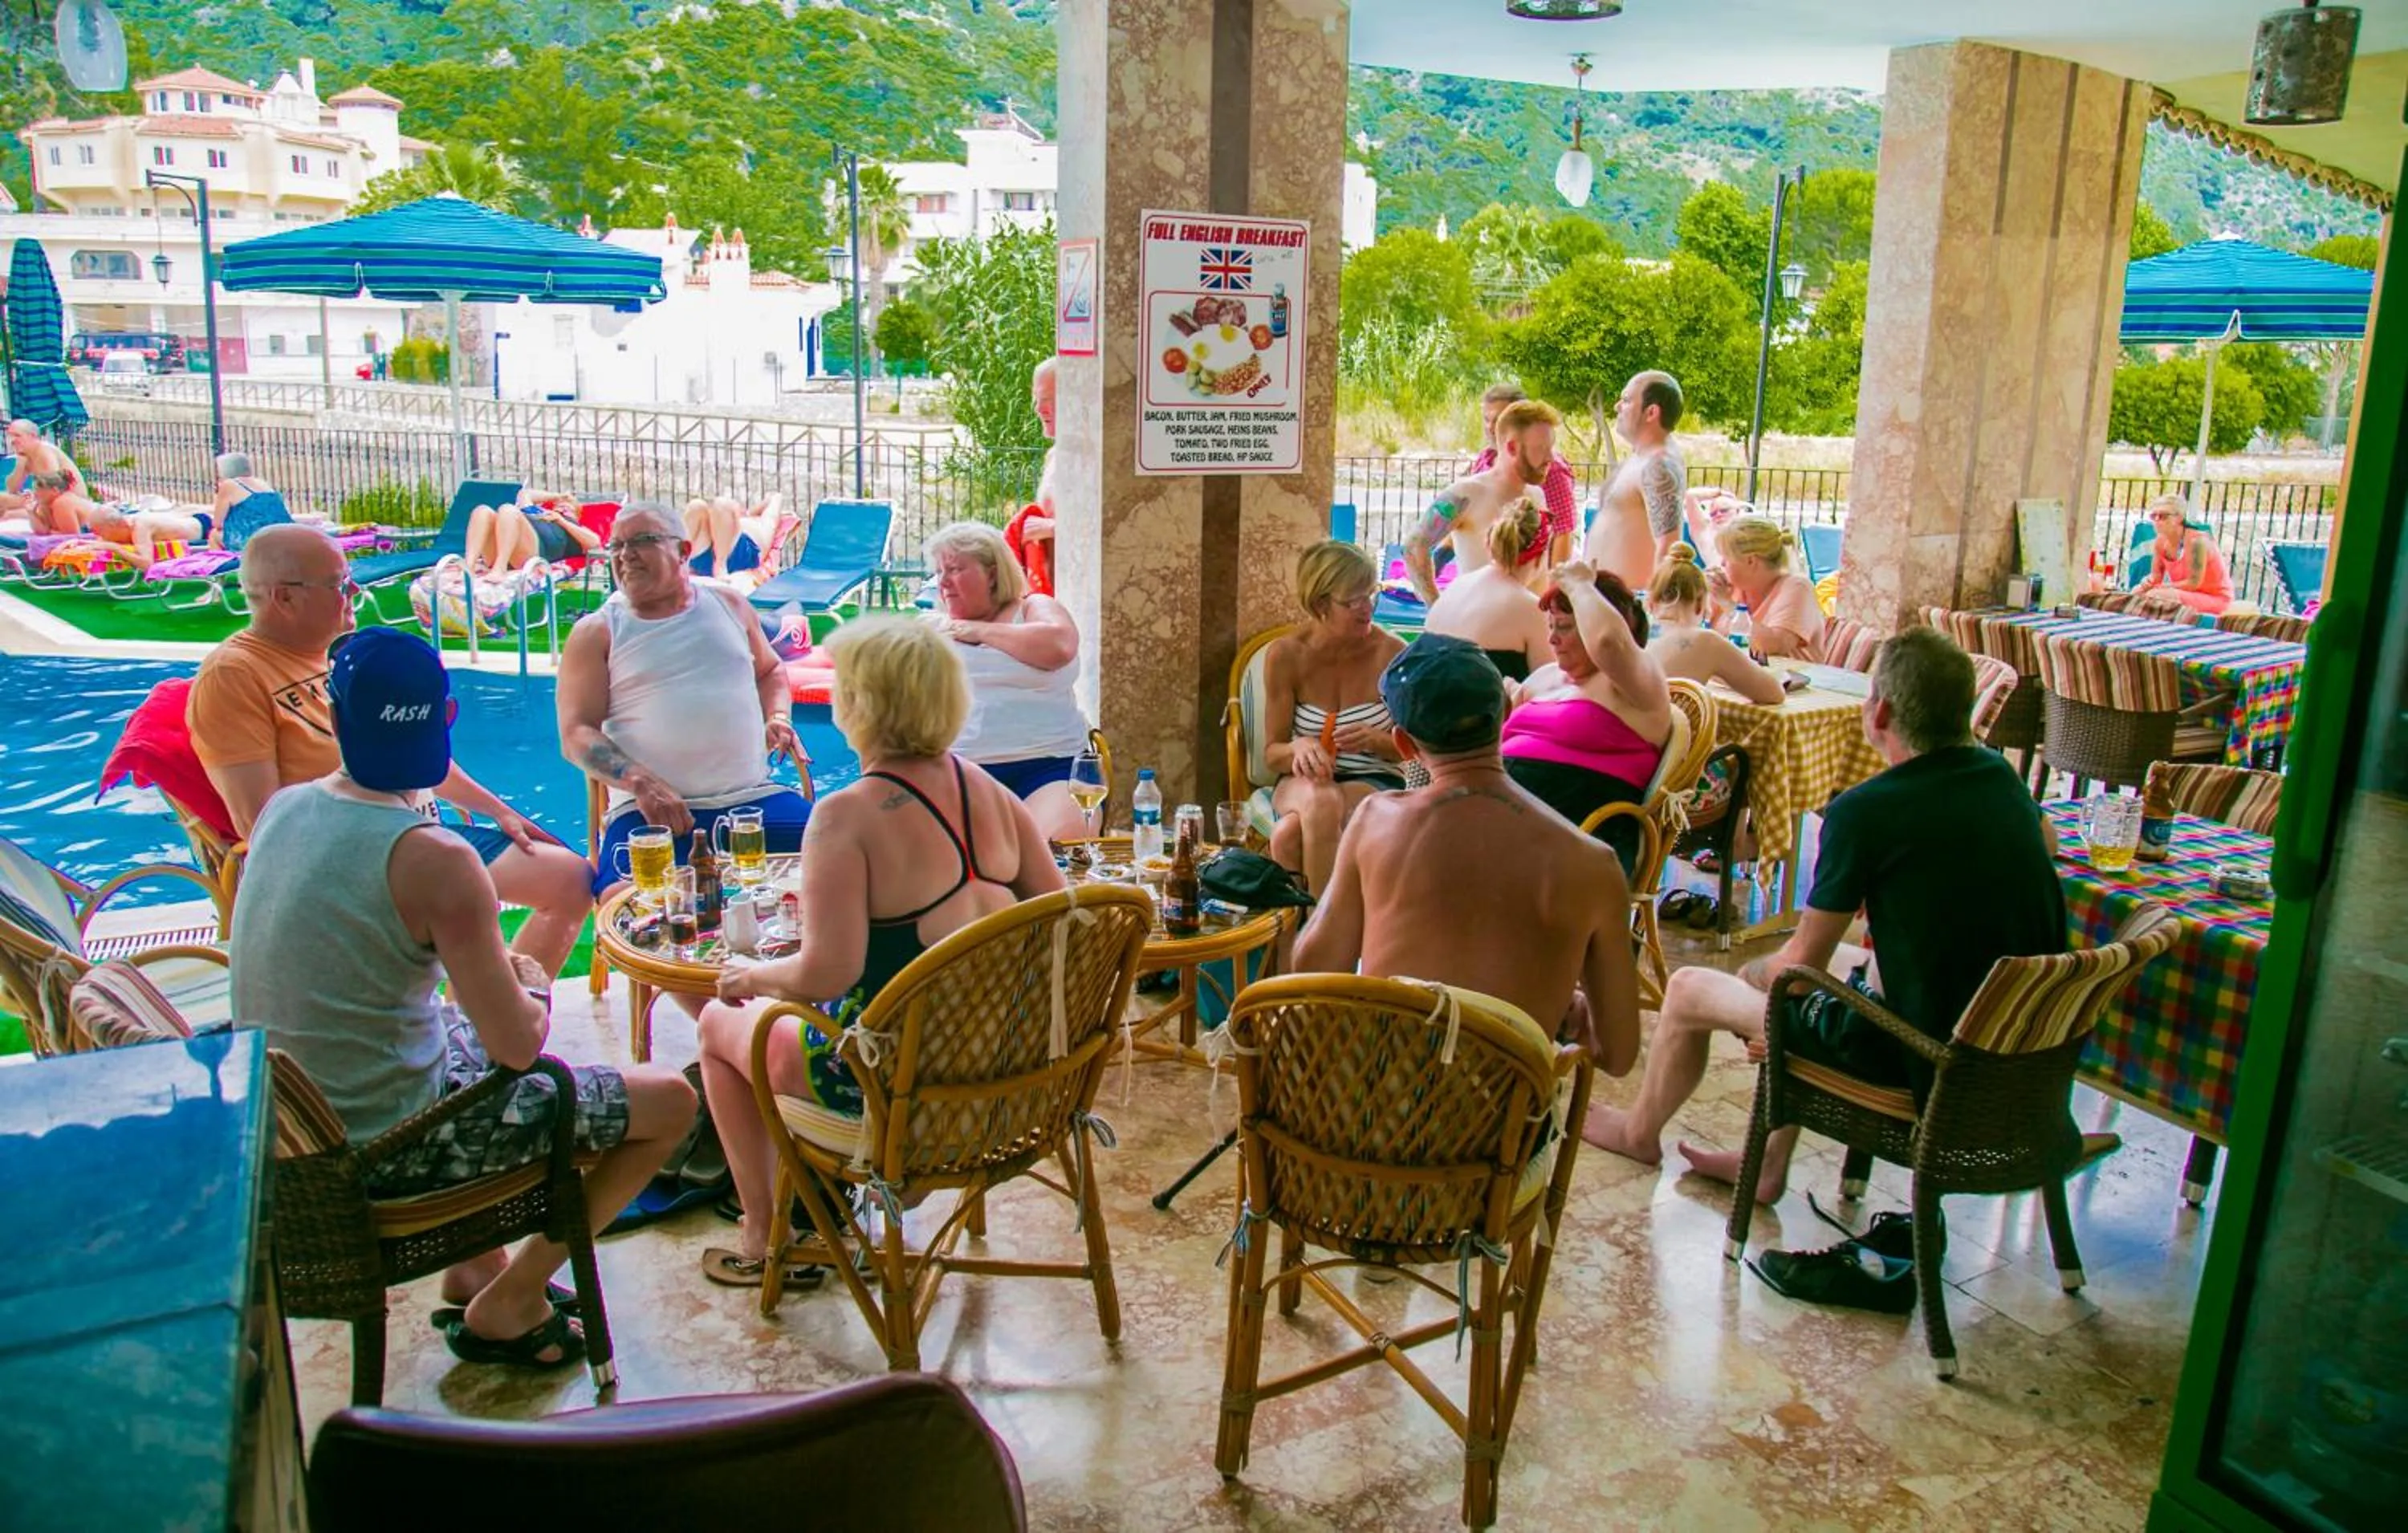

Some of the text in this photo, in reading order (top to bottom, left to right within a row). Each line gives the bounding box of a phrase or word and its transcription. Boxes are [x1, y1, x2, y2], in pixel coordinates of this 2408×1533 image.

[1146, 222, 1306, 247] FULL ENGLISH BREAKFAST
[1229, 410, 1251, 421] FRIED
[1165, 425, 1186, 435] PORK
[1210, 438, 1228, 448] TWO
[1230, 438, 1251, 448] FRIED
[1170, 451, 1206, 462] TOASTED
[1237, 452, 1247, 462] HP
[1249, 451, 1273, 462] SAUCE
[379, 703, 432, 722] RASH
